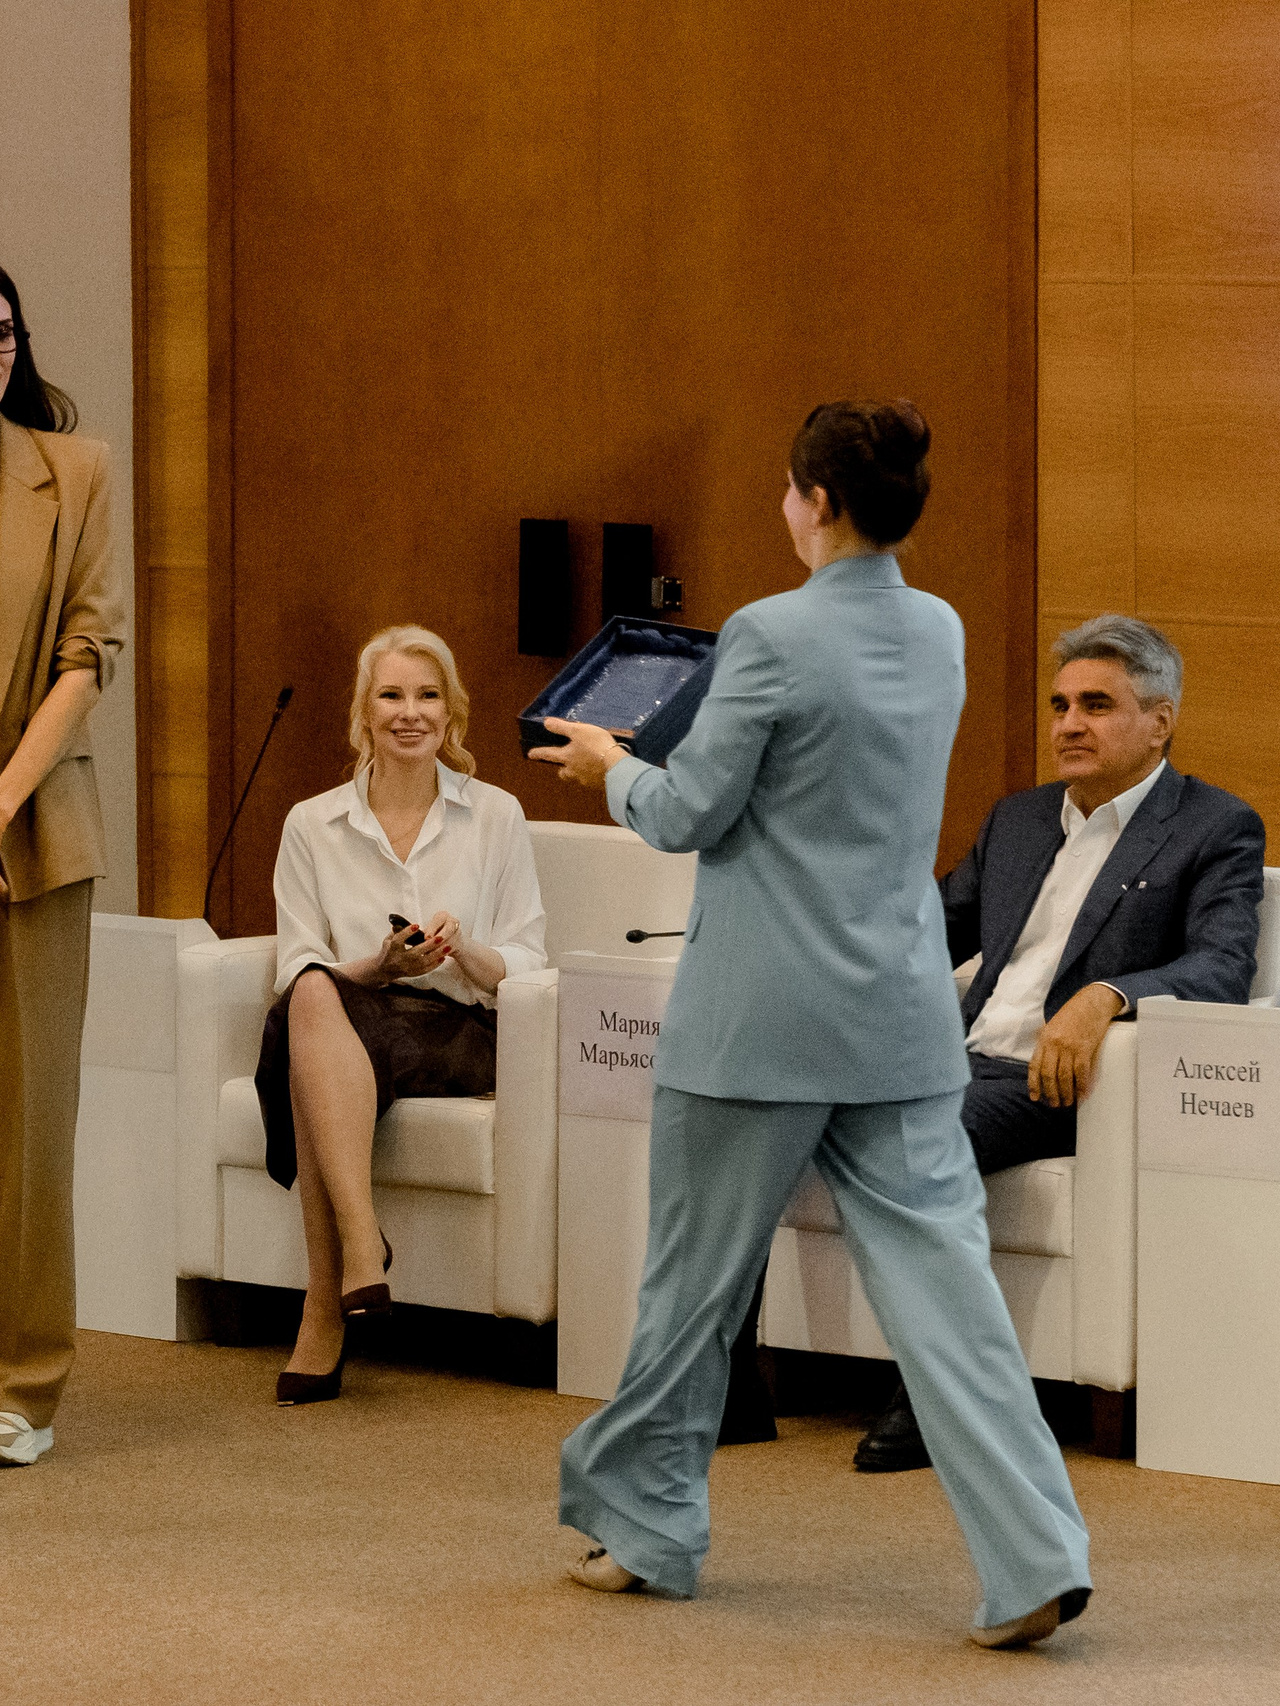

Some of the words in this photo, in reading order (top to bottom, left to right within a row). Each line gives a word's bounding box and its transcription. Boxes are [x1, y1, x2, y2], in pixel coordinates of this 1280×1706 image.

[599, 1009, 661, 1039] Мария
[1173, 1056, 1261, 1083] Алексей
[1180, 1092, 1254, 1118] Нечаев
